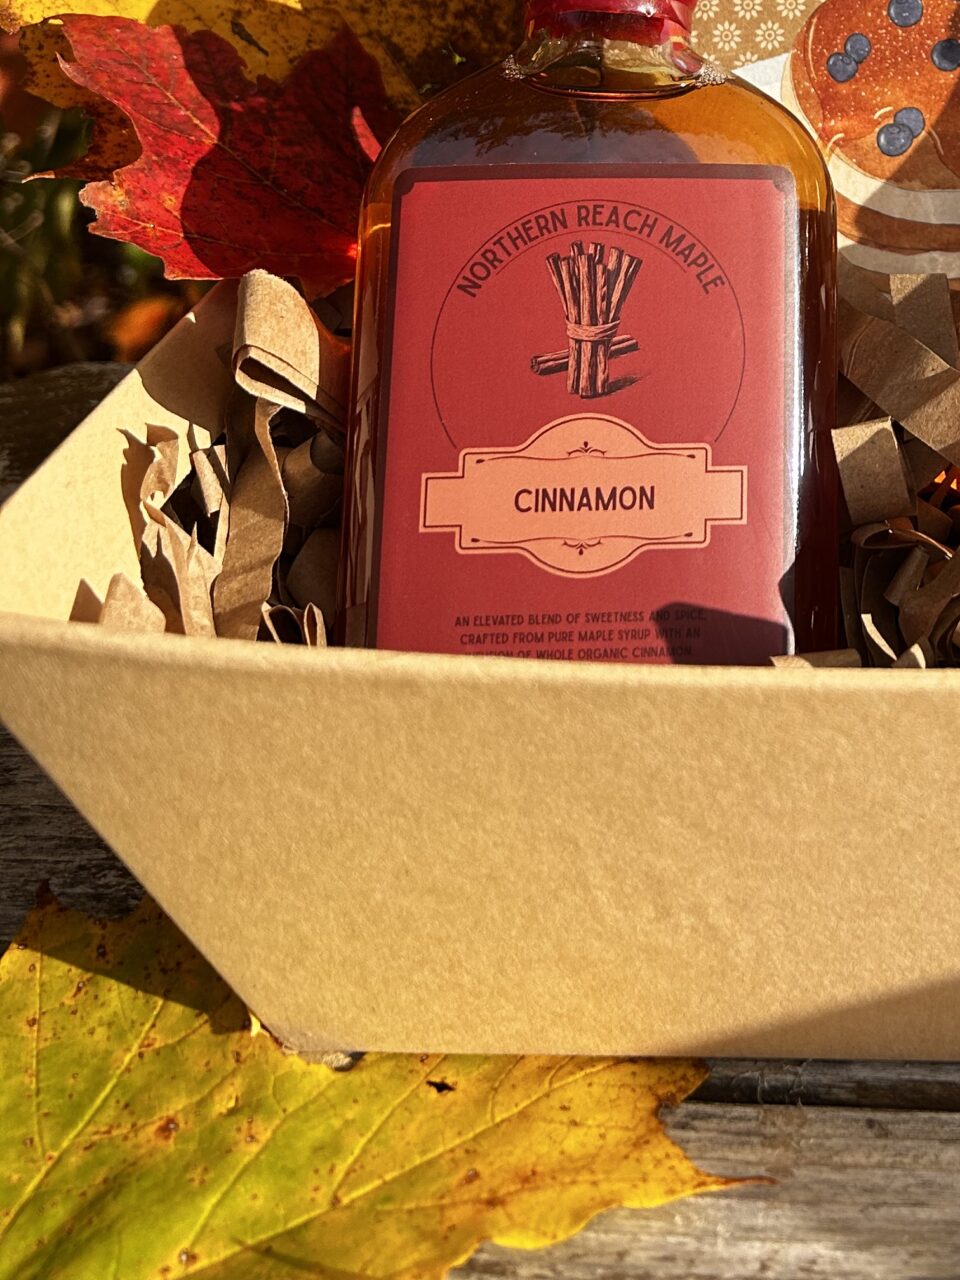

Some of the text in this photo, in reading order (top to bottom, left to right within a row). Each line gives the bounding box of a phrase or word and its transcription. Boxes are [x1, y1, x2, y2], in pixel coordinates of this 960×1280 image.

[457, 205, 725, 298] NORTHERN REACH MAPLE
[514, 485, 655, 512] CINNAMON
[455, 616, 469, 627] AN
[474, 615, 524, 627] ELEVATED
[528, 614, 561, 626] BLEND
[566, 613, 581, 625] OF
[585, 611, 644, 623] SWEETNESS
[649, 610, 670, 622] AND
[460, 627, 701, 645] CRAFTED FROM PURE MAPLE SYRUP WITH AN
[536, 648, 574, 660] WHOLE
[578, 647, 628, 660] ORGANIC
